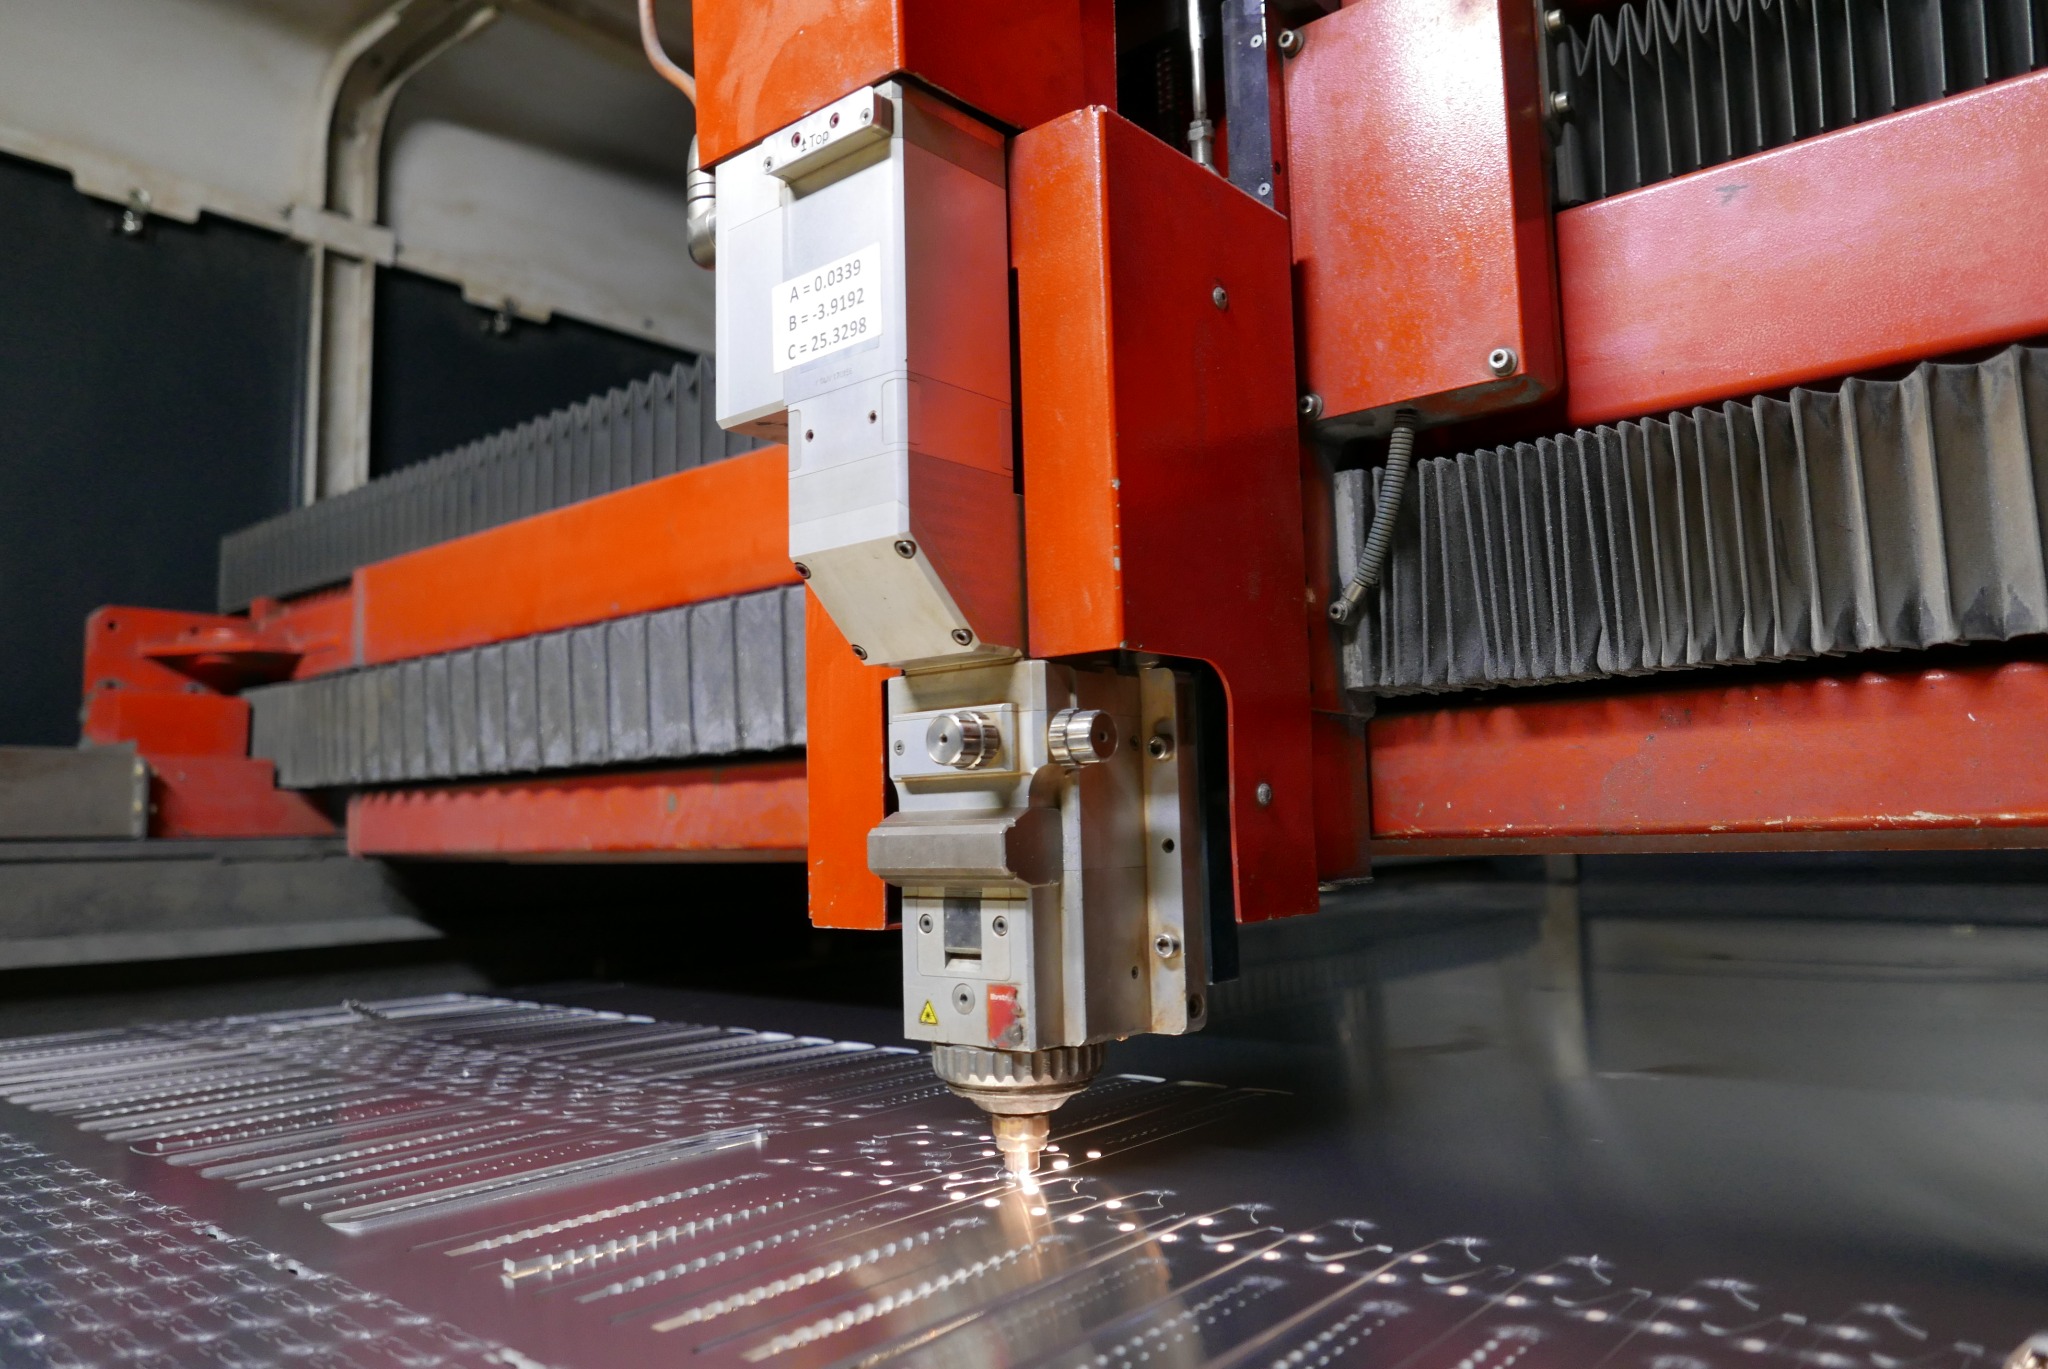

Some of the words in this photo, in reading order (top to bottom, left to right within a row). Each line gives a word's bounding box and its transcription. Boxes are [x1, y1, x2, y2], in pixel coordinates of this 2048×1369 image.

[810, 131, 829, 147] Top
[790, 286, 799, 303] A
[803, 284, 811, 294] =
[814, 259, 861, 292] 0.0339
[789, 315, 797, 332] B
[801, 314, 808, 323] =
[812, 288, 865, 320] -3.9192
[788, 344, 796, 361] C
[799, 343, 807, 353] =
[811, 317, 867, 352] 25.3298
